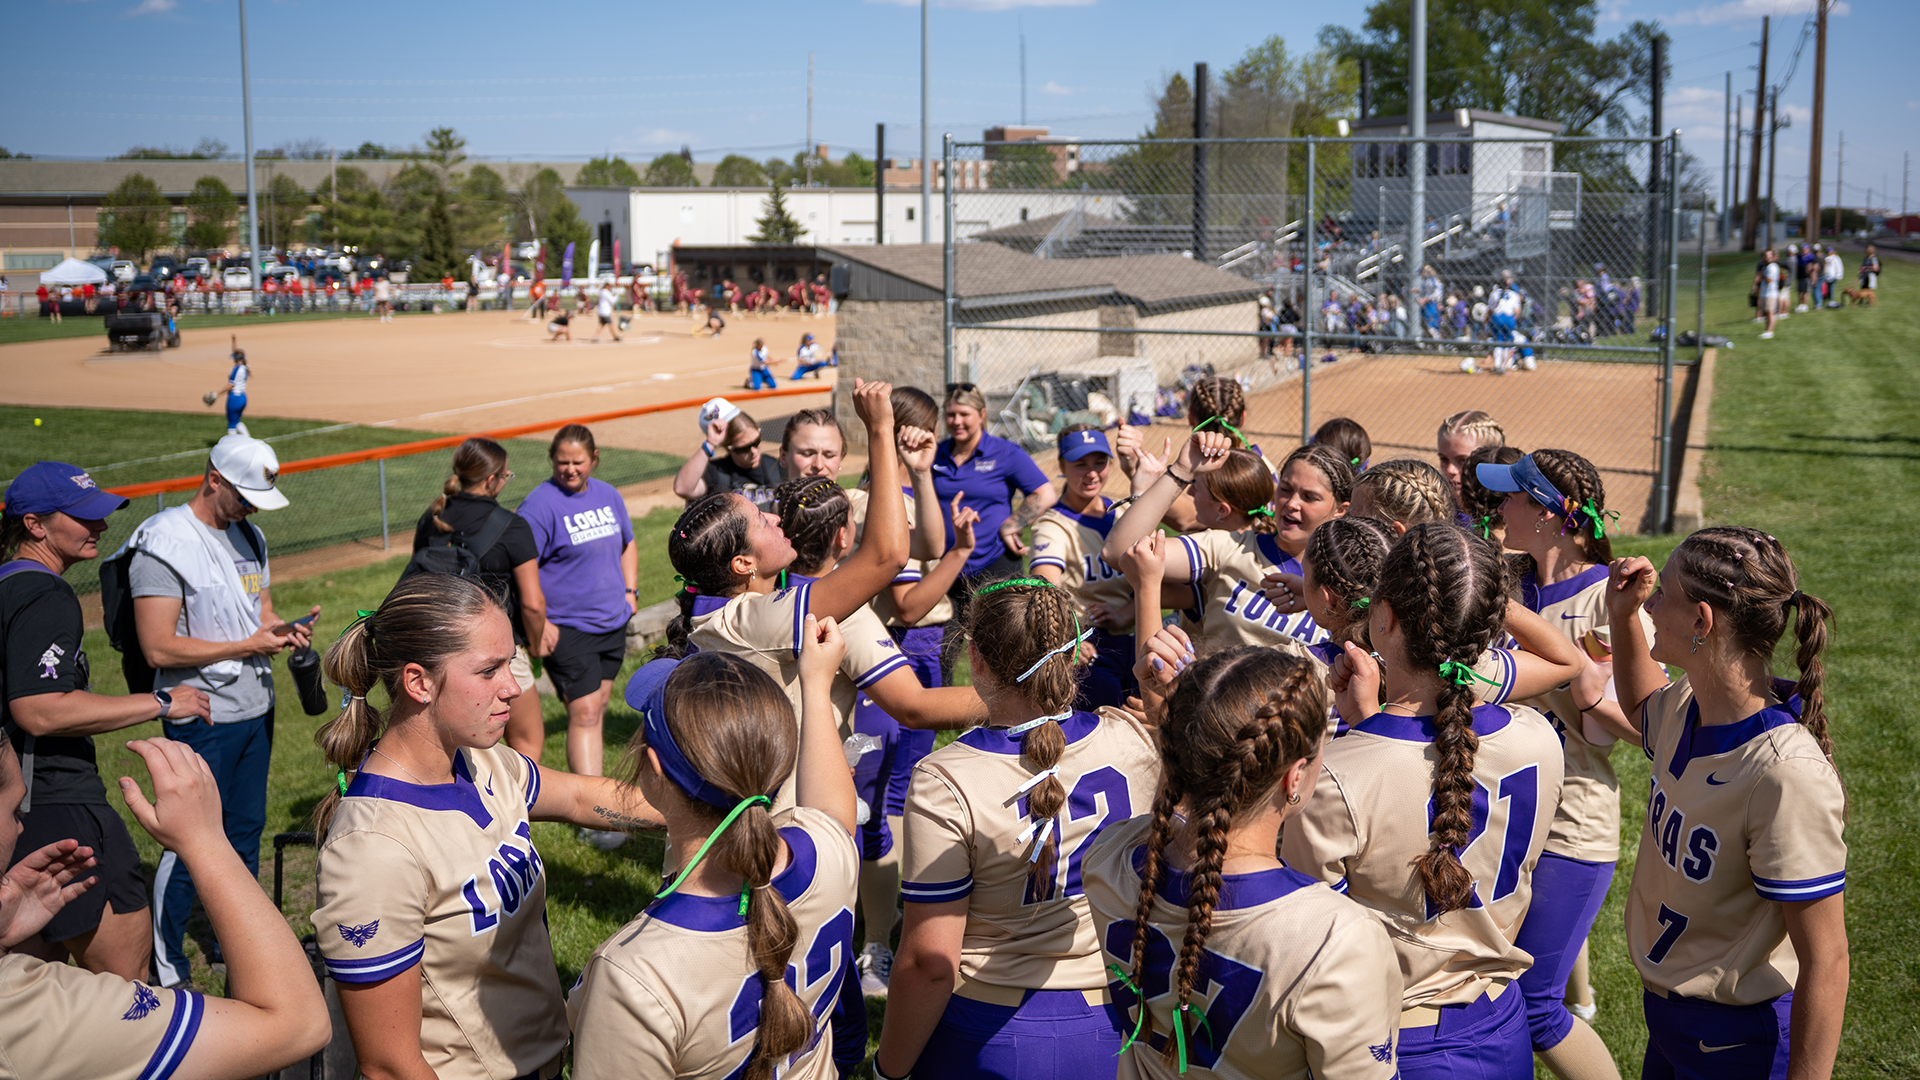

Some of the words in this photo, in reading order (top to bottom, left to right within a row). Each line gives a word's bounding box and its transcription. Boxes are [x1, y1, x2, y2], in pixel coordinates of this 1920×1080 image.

[1081, 430, 1096, 444] L
[563, 505, 616, 534] LORAS
[1223, 578, 1332, 647] LORA
[1647, 785, 1721, 885] RAS
[1645, 901, 1690, 966] 7
[1105, 918, 1266, 1072] 27
